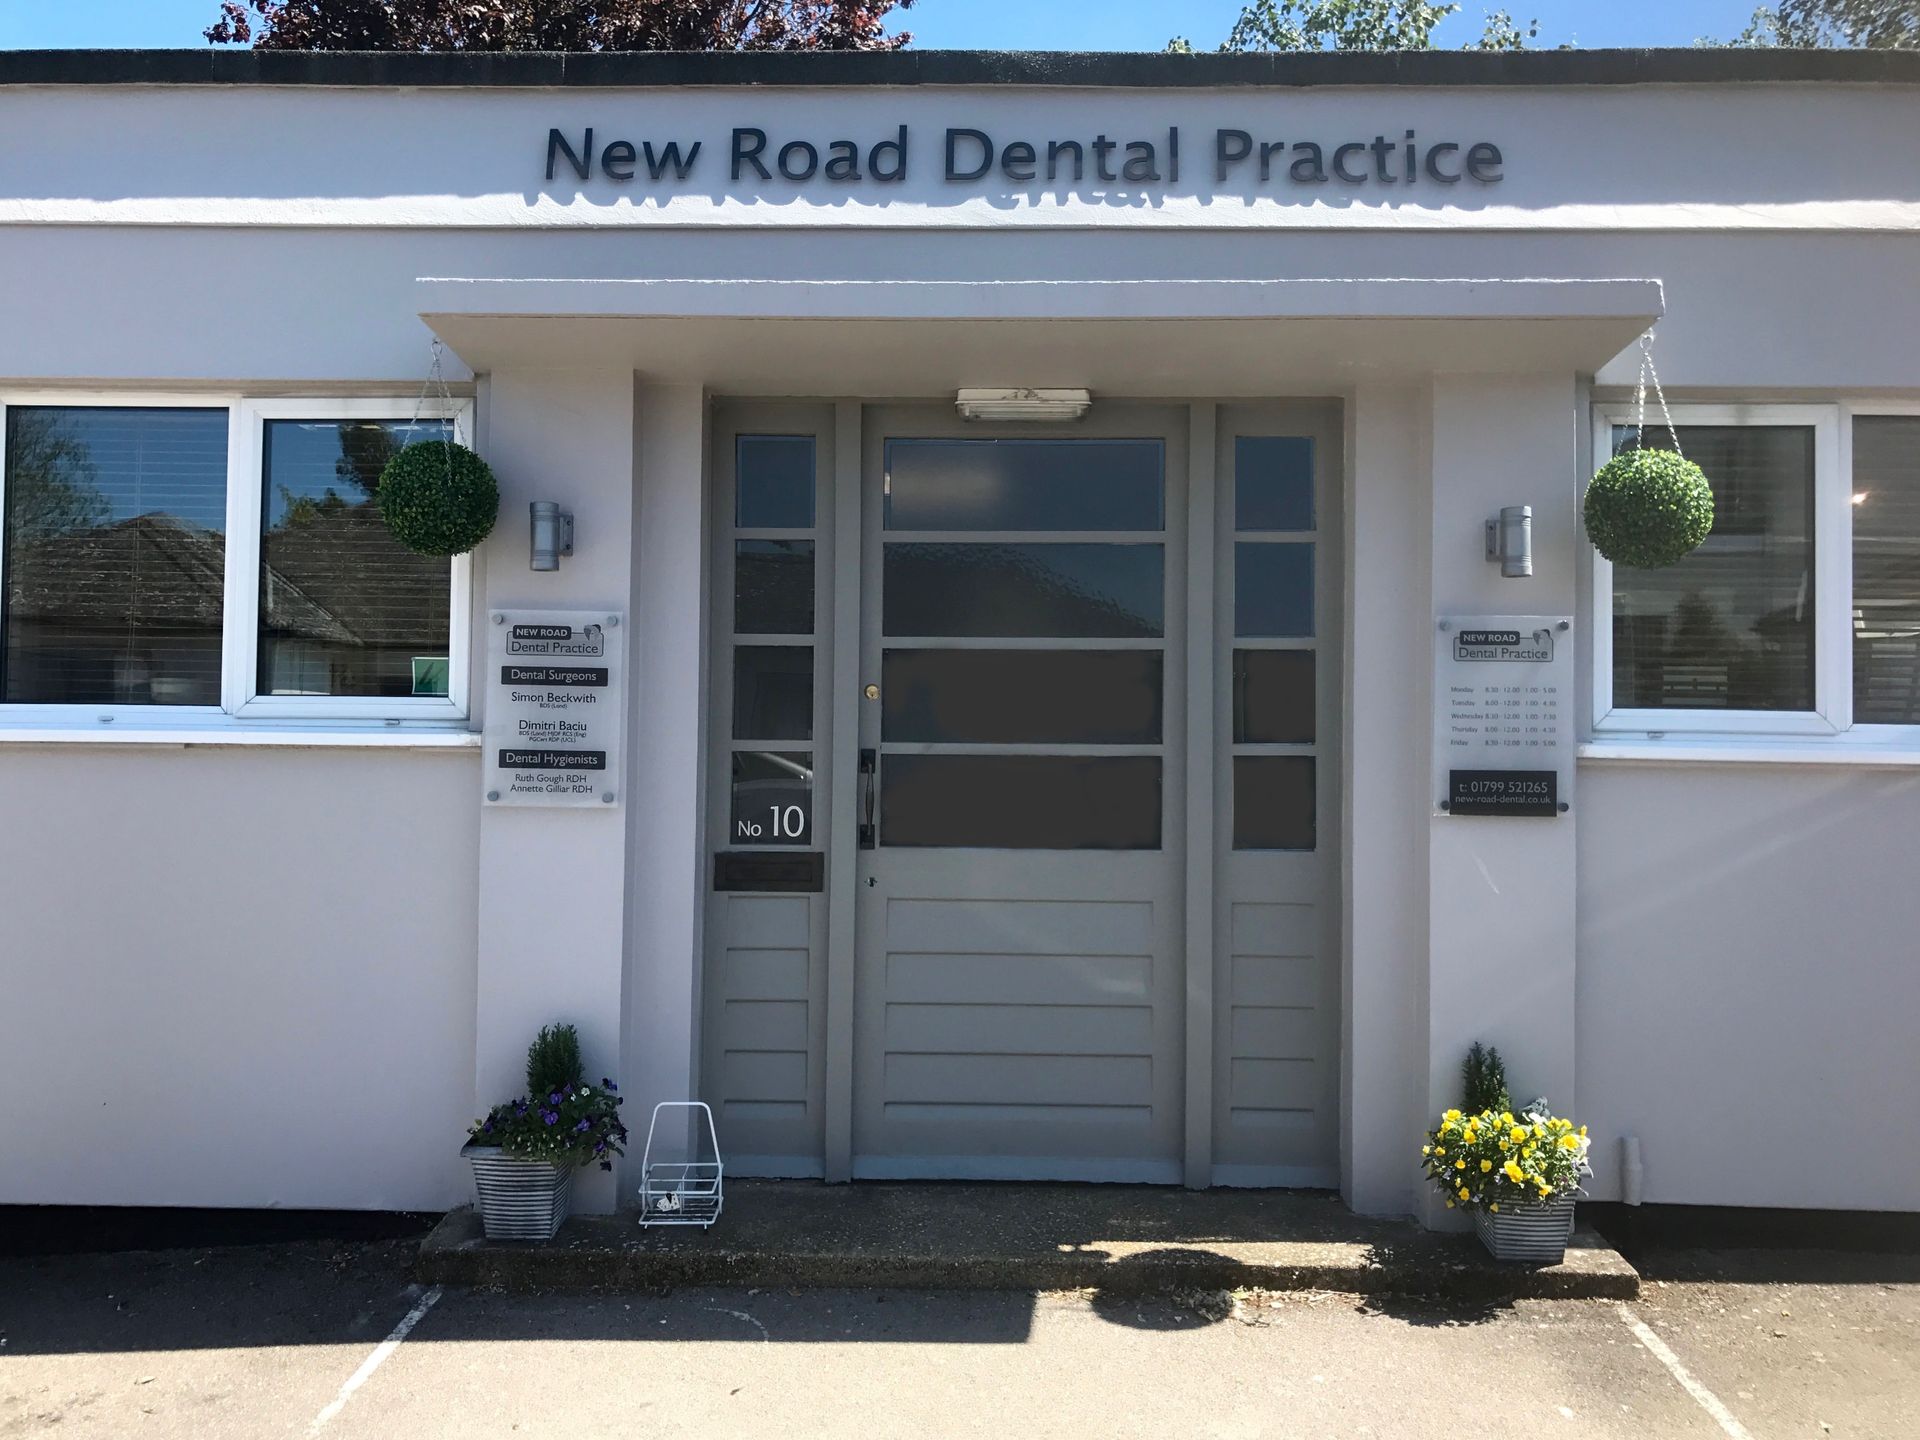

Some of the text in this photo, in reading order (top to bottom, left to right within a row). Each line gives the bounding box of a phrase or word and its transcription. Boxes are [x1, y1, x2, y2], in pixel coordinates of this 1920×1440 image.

[545, 124, 1505, 184] New Road Dental Practice
[516, 628, 568, 637] NEW ROAD
[1463, 634, 1516, 642] NEW ROAD
[512, 642, 598, 653] Dental Practice
[1458, 647, 1548, 659] Dental Practice
[512, 669, 597, 683] Dental Surgeons
[512, 692, 596, 703] Simon Beckwith
[519, 720, 587, 730] Dimitri Baciu
[506, 753, 598, 766] Dental Hygienists
[515, 774, 587, 784] Ruth Gough RDH
[510, 784, 543, 793] Annette
[572, 785, 593, 793] RDH
[1471, 781, 1504, 792] 01799
[1508, 782, 1548, 793] 521265
[1456, 795, 1551, 804] new-road-dental.co.uk
[738, 806, 804, 837] No 10
